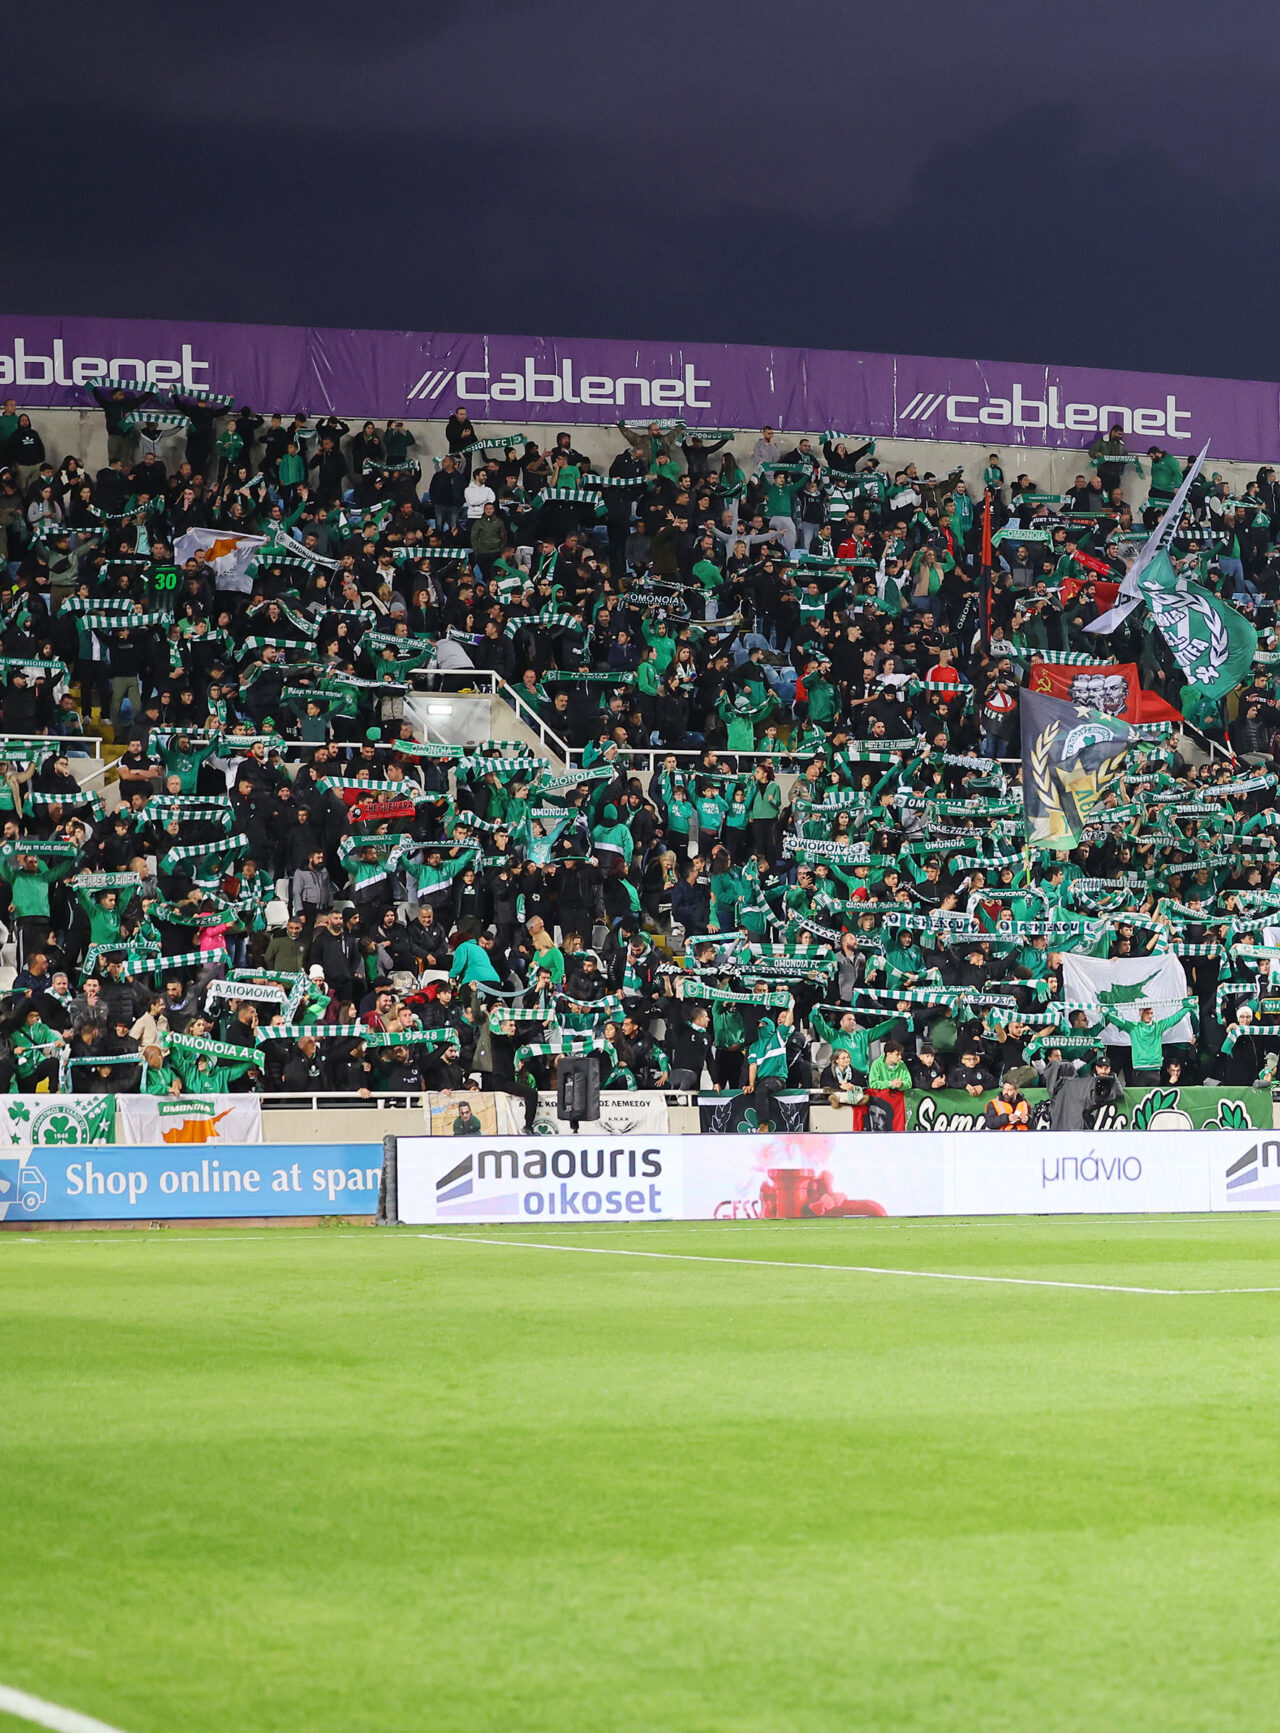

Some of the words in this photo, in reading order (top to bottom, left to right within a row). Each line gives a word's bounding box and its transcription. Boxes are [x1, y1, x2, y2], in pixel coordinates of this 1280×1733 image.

[455, 356, 710, 409] cablenet
[946, 384, 1192, 439] cablenet
[1007, 530, 1047, 540] OMONOIA
[154, 573, 178, 590] 30
[630, 594, 679, 605] OMONOIA
[411, 744, 452, 754] OMONOIA
[364, 804, 378, 813] CHE
[379, 802, 412, 812] GUEVARA
[909, 797, 961, 807] OMNOIA
[531, 808, 568, 816] OMONOIA
[1177, 803, 1219, 813] OMONOIA
[925, 839, 965, 850] OMONOIA
[829, 855, 840, 864] 76
[842, 854, 871, 864] YEARS
[1169, 862, 1206, 873] OMONOIA
[846, 901, 878, 909] OMONOIA
[907, 917, 964, 930] ATHIENOU
[1019, 922, 1077, 932] ATHIENOU
[773, 959, 808, 968] OMONOIA
[809, 959, 819, 968] FC
[711, 990, 750, 1000] OMONOIA
[751, 993, 762, 1001] FC
[172, 1033, 237, 1054] OMONOIA
[1042, 1037, 1094, 1047] OMONOIA
[162, 1104, 211, 1113] OMONOIA
[54, 1132, 68, 1140] 1948
[478, 1149, 662, 1179] maouris
[1042, 1149, 1142, 1188] μπάνιο
[66, 1161, 147, 1204] Shop
[160, 1160, 260, 1193] online
[271, 1163, 302, 1192] at
[523, 1183, 662, 1215] oikoset
